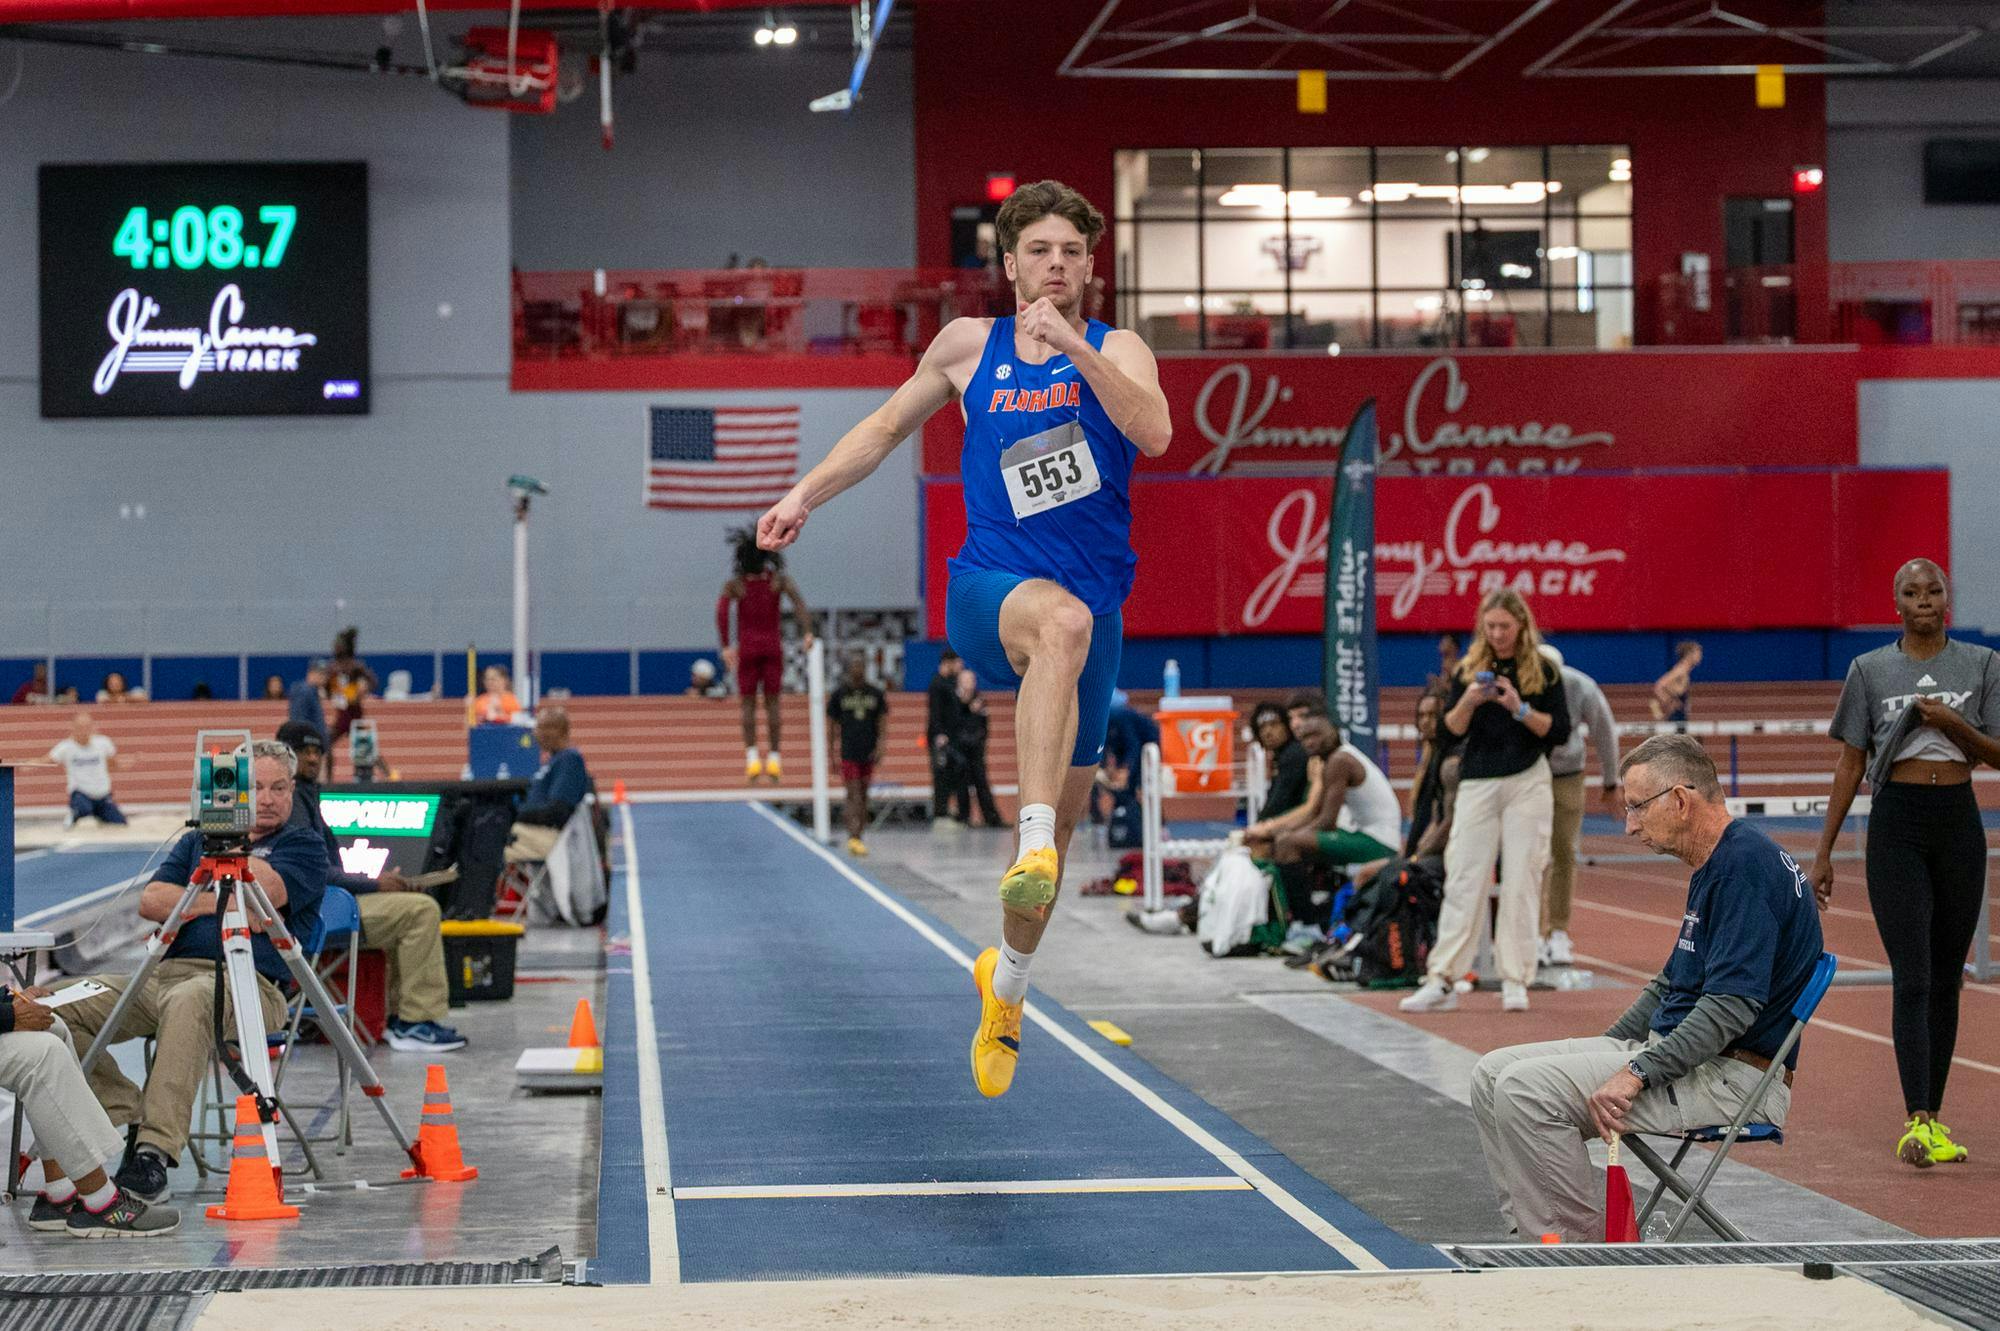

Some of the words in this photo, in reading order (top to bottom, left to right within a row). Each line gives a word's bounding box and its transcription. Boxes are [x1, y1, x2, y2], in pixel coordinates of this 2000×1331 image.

[112, 205, 297, 270] 4:08.7
[93, 288, 212, 395] Jimmy
[215, 349, 301, 371] TRACK
[995, 364, 1012, 380] SEC
[988, 382, 1081, 413] FLORIDA
[1190, 364, 1403, 475] Jimm
[1018, 450, 1082, 498] 553
[1453, 570, 1597, 594] TRACK
